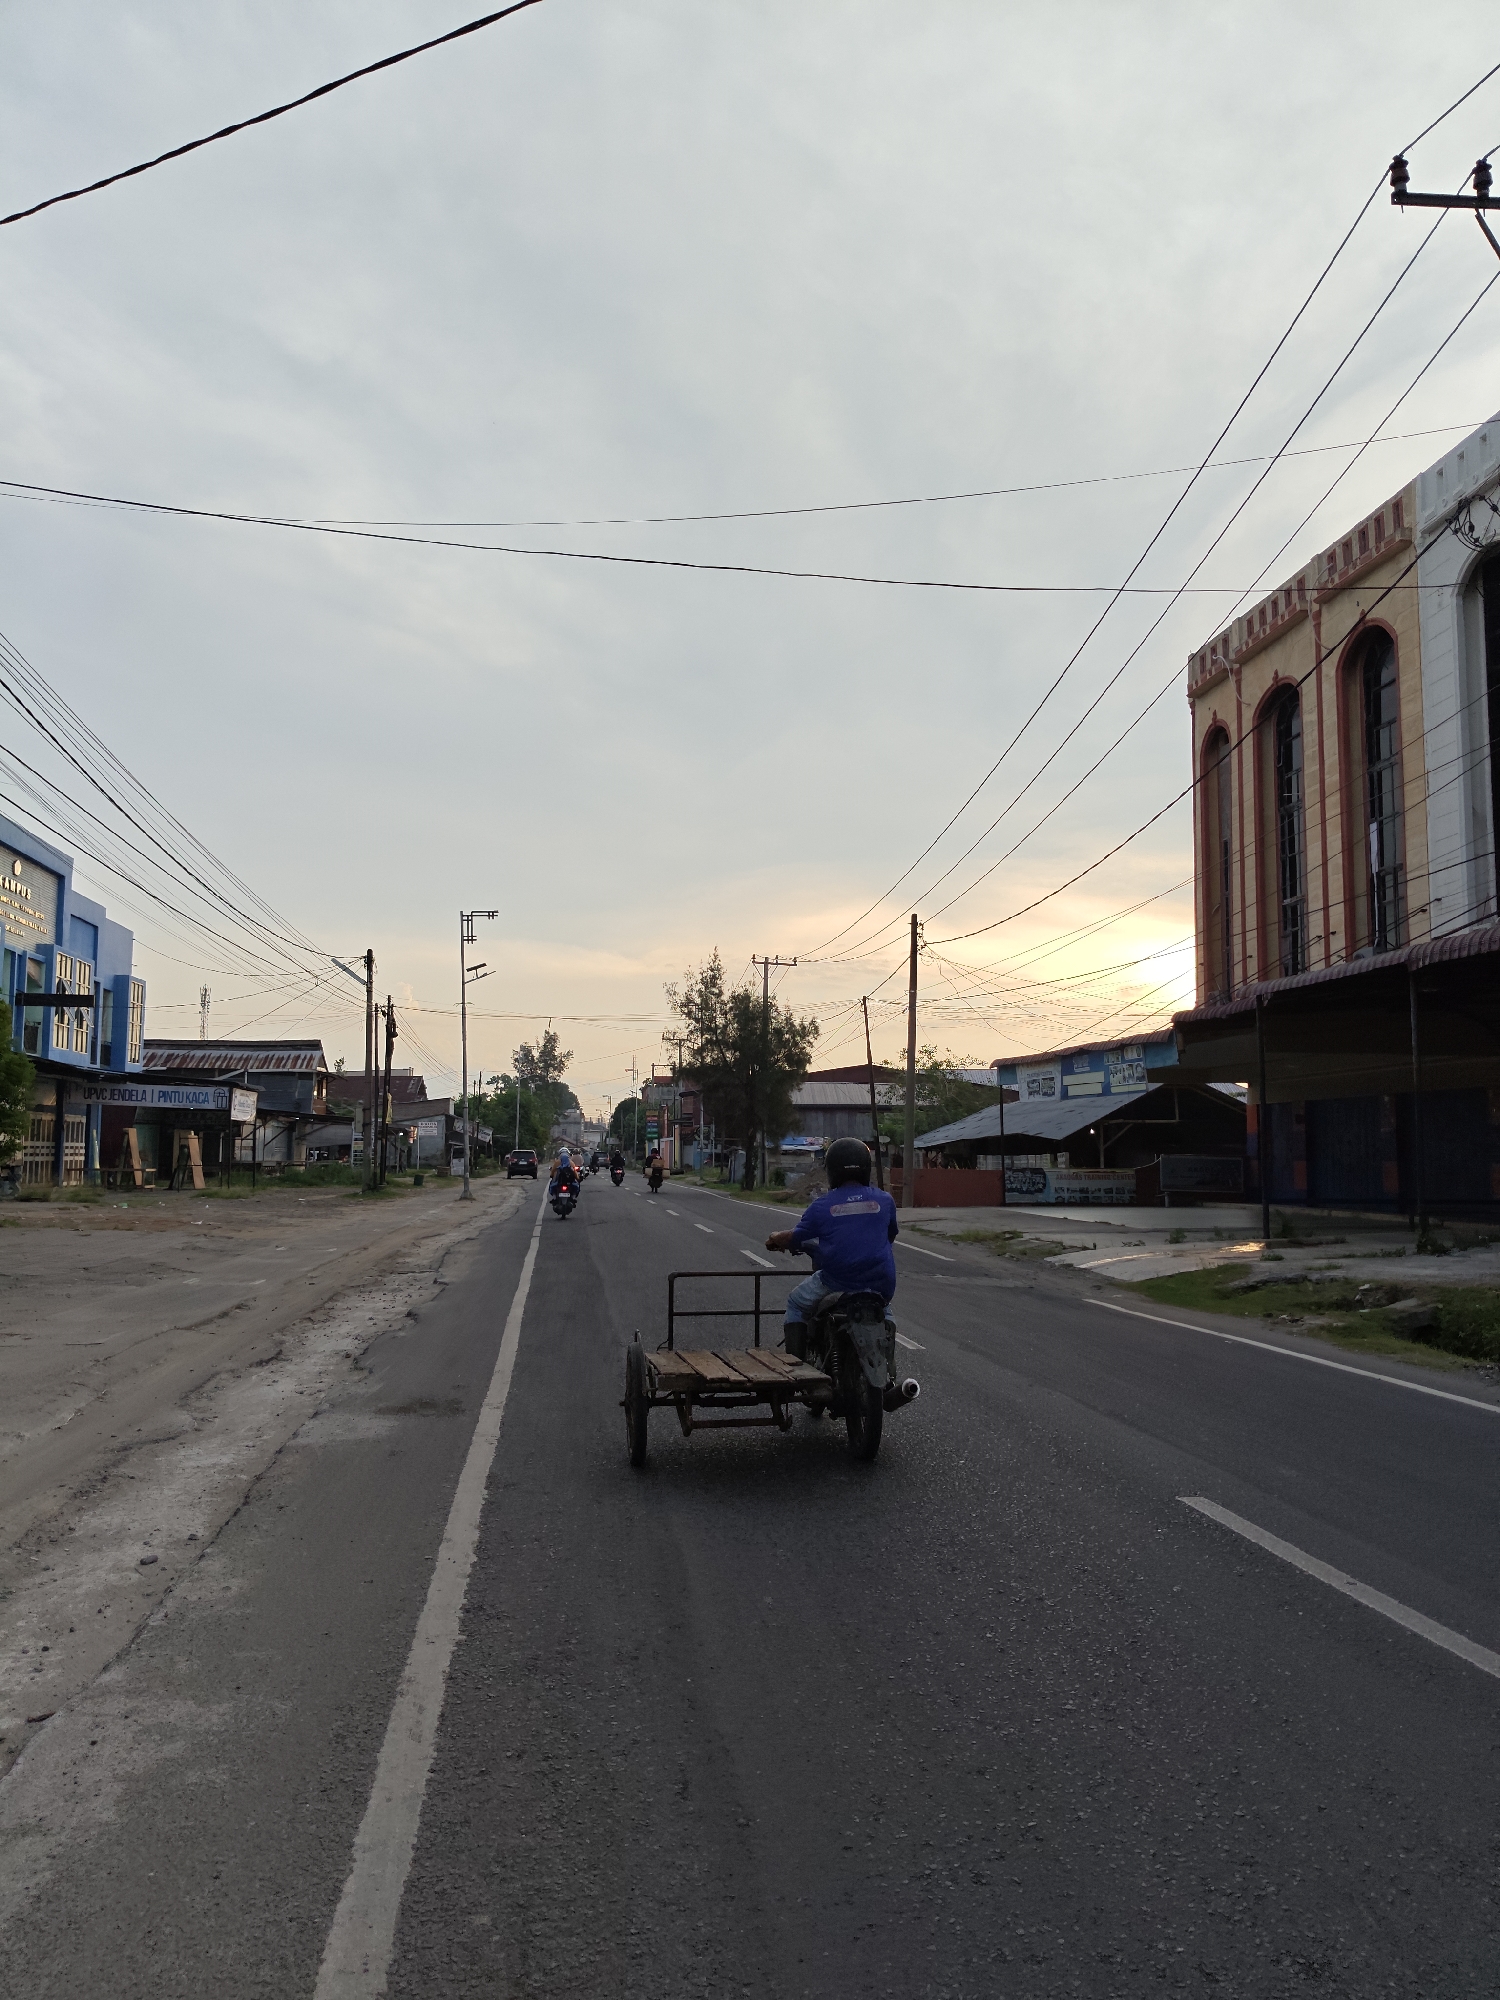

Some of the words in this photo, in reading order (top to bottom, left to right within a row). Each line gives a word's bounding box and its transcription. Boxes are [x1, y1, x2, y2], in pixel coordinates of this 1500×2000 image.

[83, 1086, 107, 1101] UPVC
[108, 1088, 147, 1103] JENDELA
[157, 1090, 184, 1104] PINTU
[186, 1091, 210, 1105] KACA
